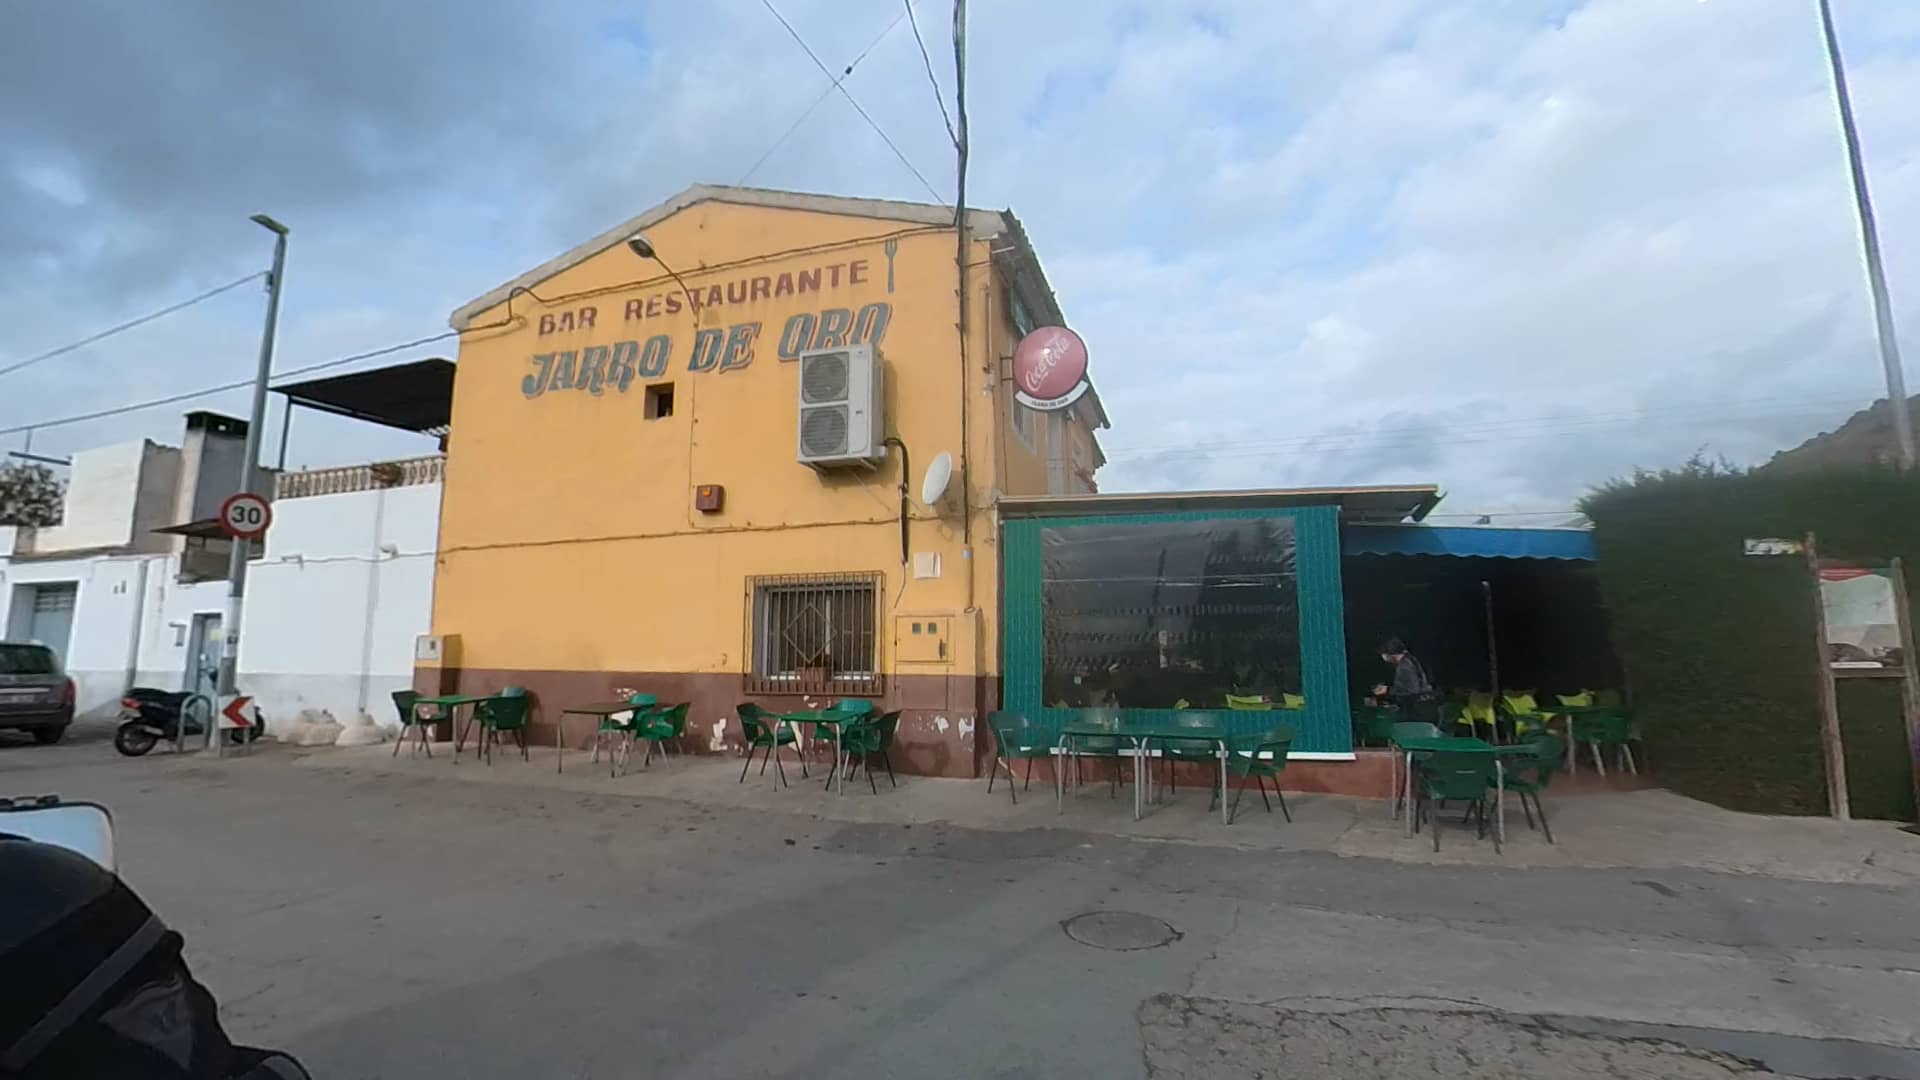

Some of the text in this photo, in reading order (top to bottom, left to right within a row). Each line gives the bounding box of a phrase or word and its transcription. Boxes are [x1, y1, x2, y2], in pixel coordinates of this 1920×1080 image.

[539, 260, 869, 335] BAR RESTAURANTE
[522, 302, 892, 398] JARRO DE ORO
[232, 505, 261, 524] 30
